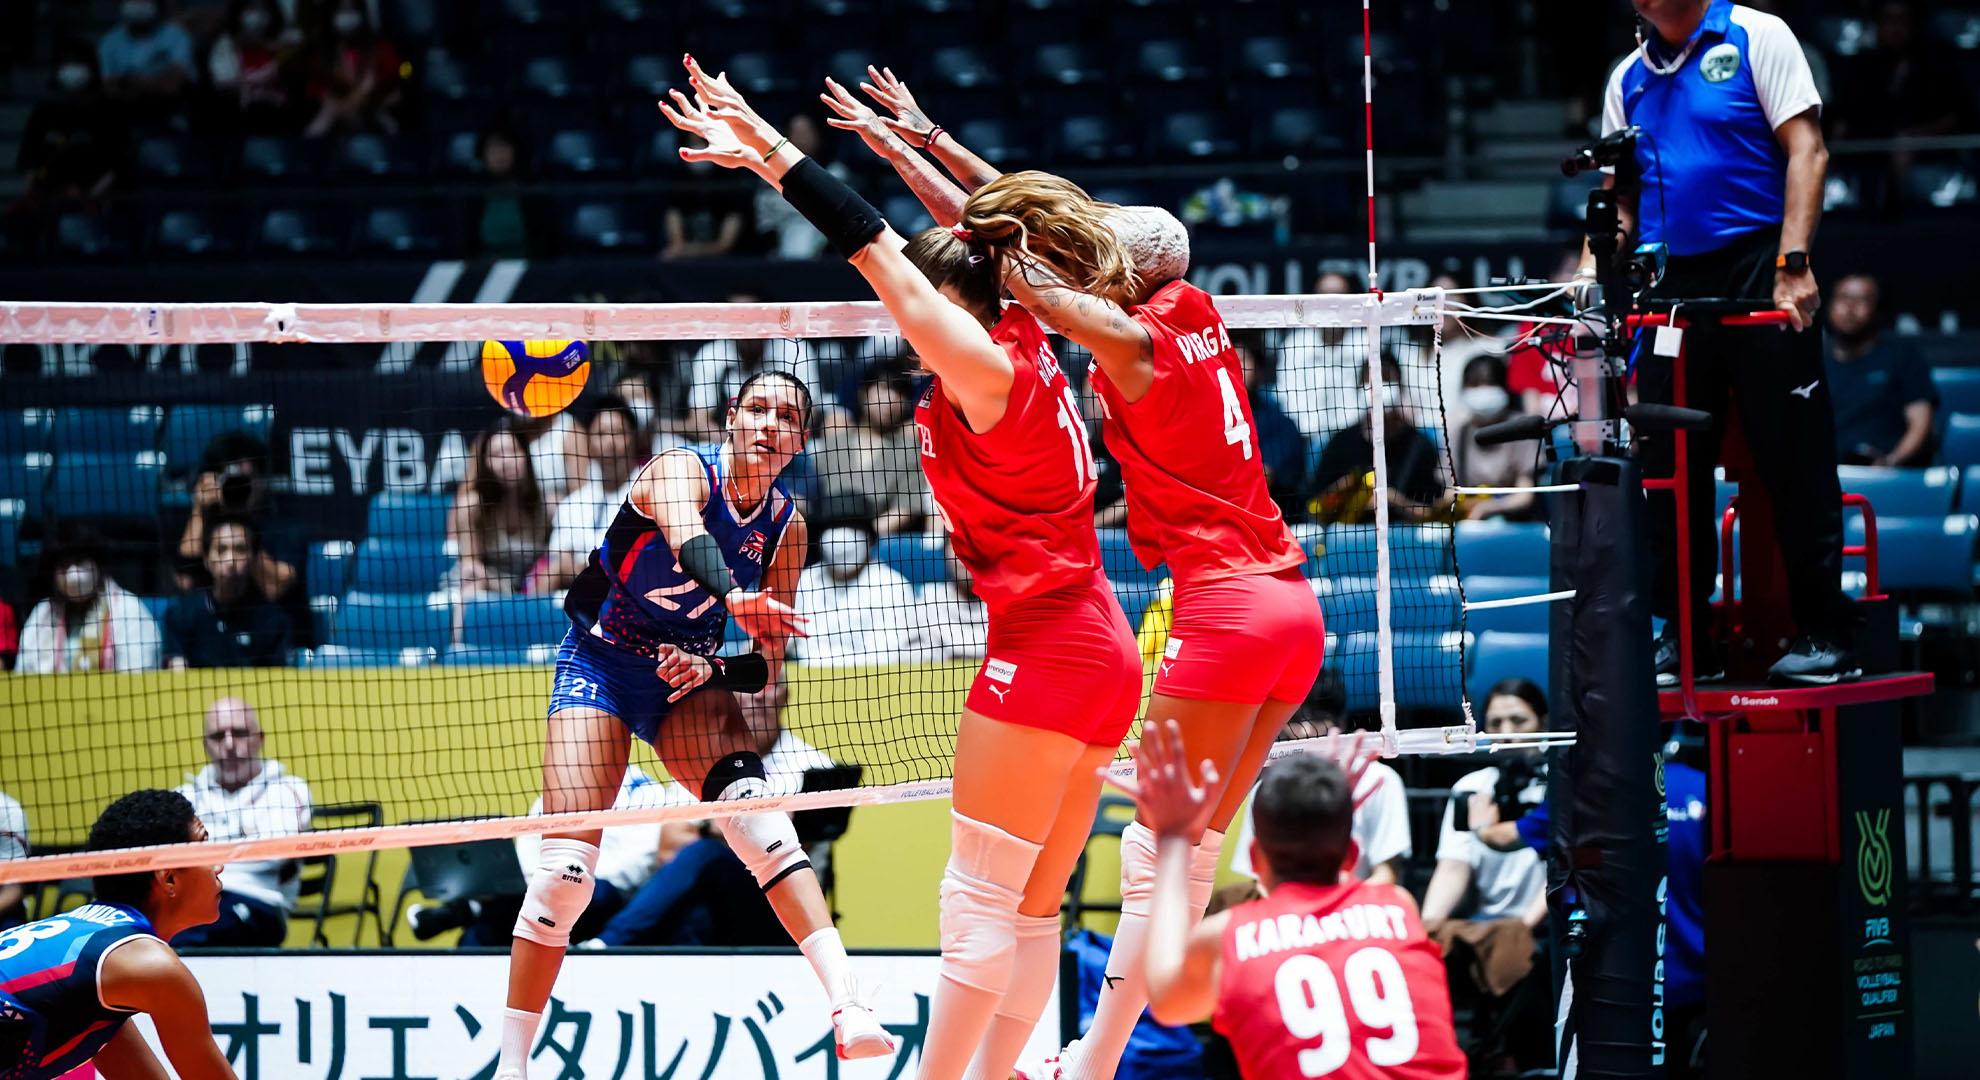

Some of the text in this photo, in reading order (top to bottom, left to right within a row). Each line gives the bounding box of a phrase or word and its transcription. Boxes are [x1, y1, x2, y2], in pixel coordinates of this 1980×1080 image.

[1217, 367, 1252, 460] 4
[569, 677, 599, 700] 21
[561, 873, 583, 884] errea
[1235, 904, 1408, 961] KARAKURT
[1865, 917, 1889, 938] FIVB
[1857, 972, 1901, 989] VOLLEYBALL
[1274, 946, 1419, 1078] 99
[1868, 1022, 1896, 1040] JAPAN
